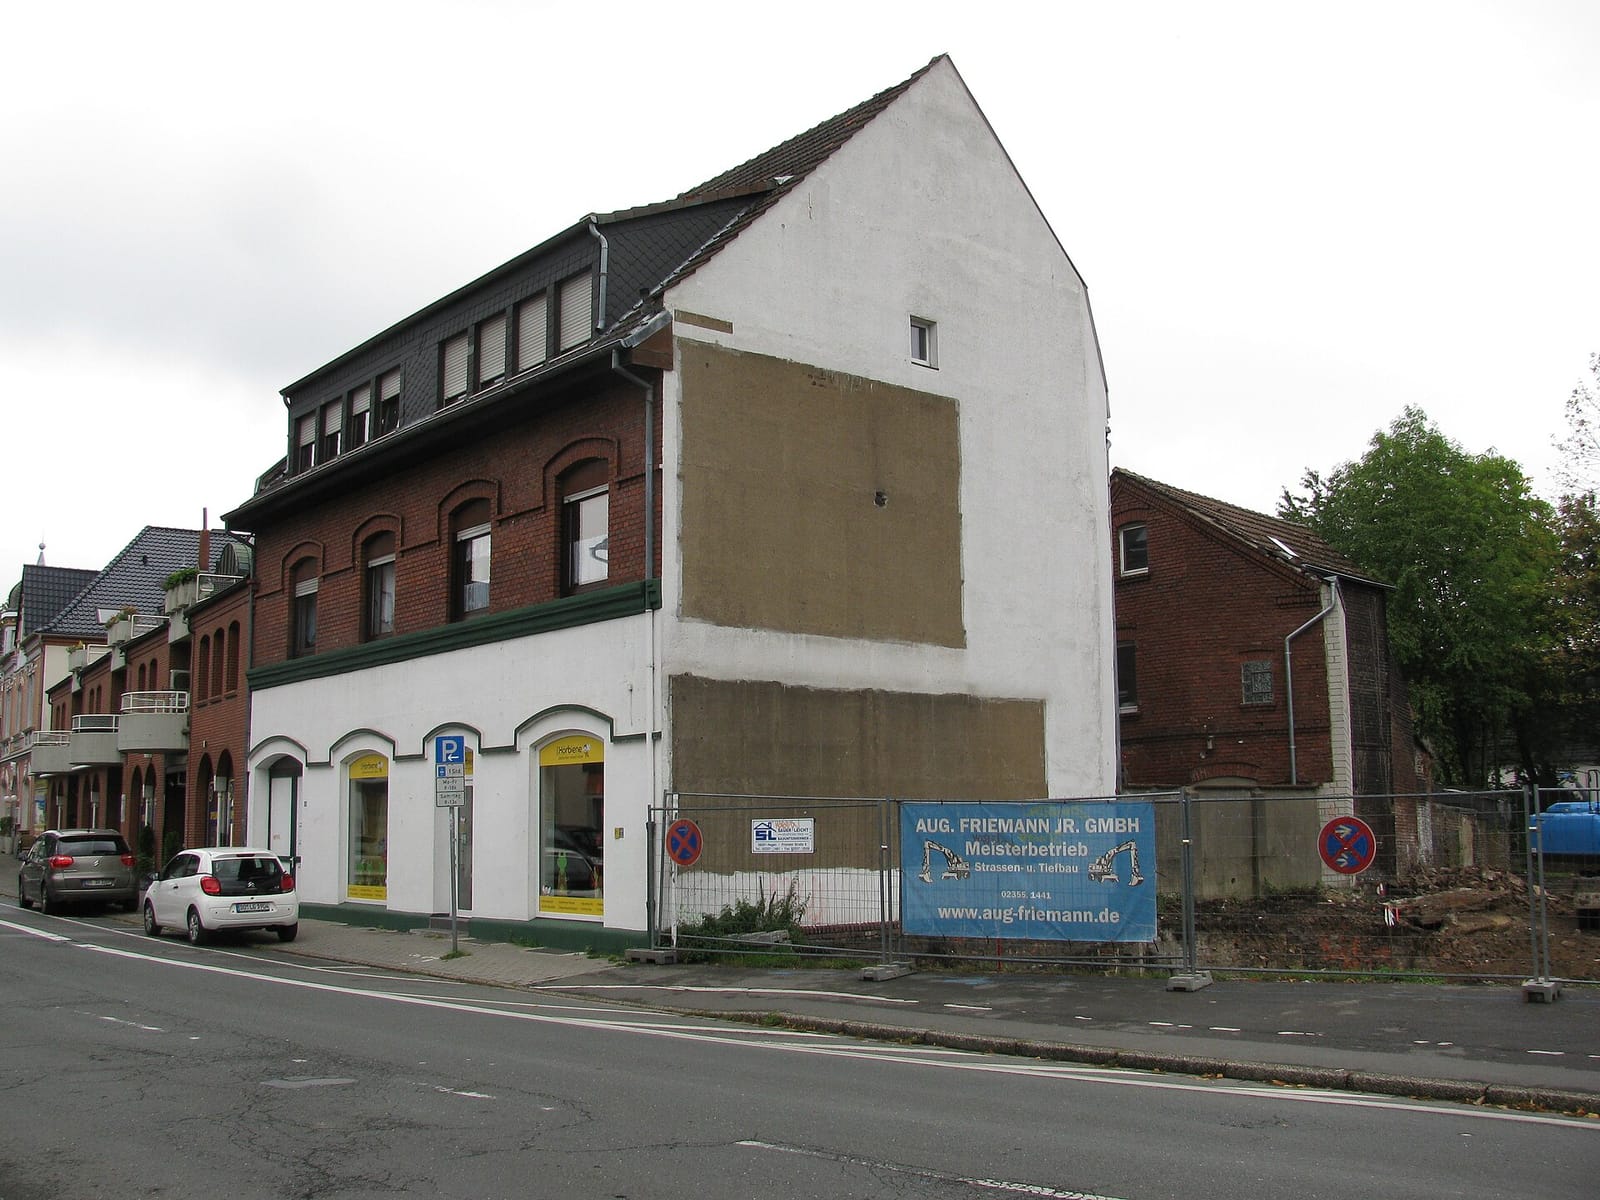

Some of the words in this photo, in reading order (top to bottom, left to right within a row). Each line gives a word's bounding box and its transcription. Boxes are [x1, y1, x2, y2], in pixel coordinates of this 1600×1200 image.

[442, 739, 457, 762] P
[915, 818, 954, 833] AUG.
[960, 818, 1050, 833] FRIEMANN
[1055, 818, 1079, 833] JR.
[1085, 818, 1140, 833] GMBH
[755, 830, 776, 840] SL
[965, 840, 1088, 857] Meisterbetrieb
[974, 862, 1024, 872] Strassen-
[1027, 864, 1036, 873] u.
[1038, 862, 1078, 873] Tiefbau
[1030, 891, 1051, 900] 1441
[937, 905, 1120, 923] www.aug-friemann.de
